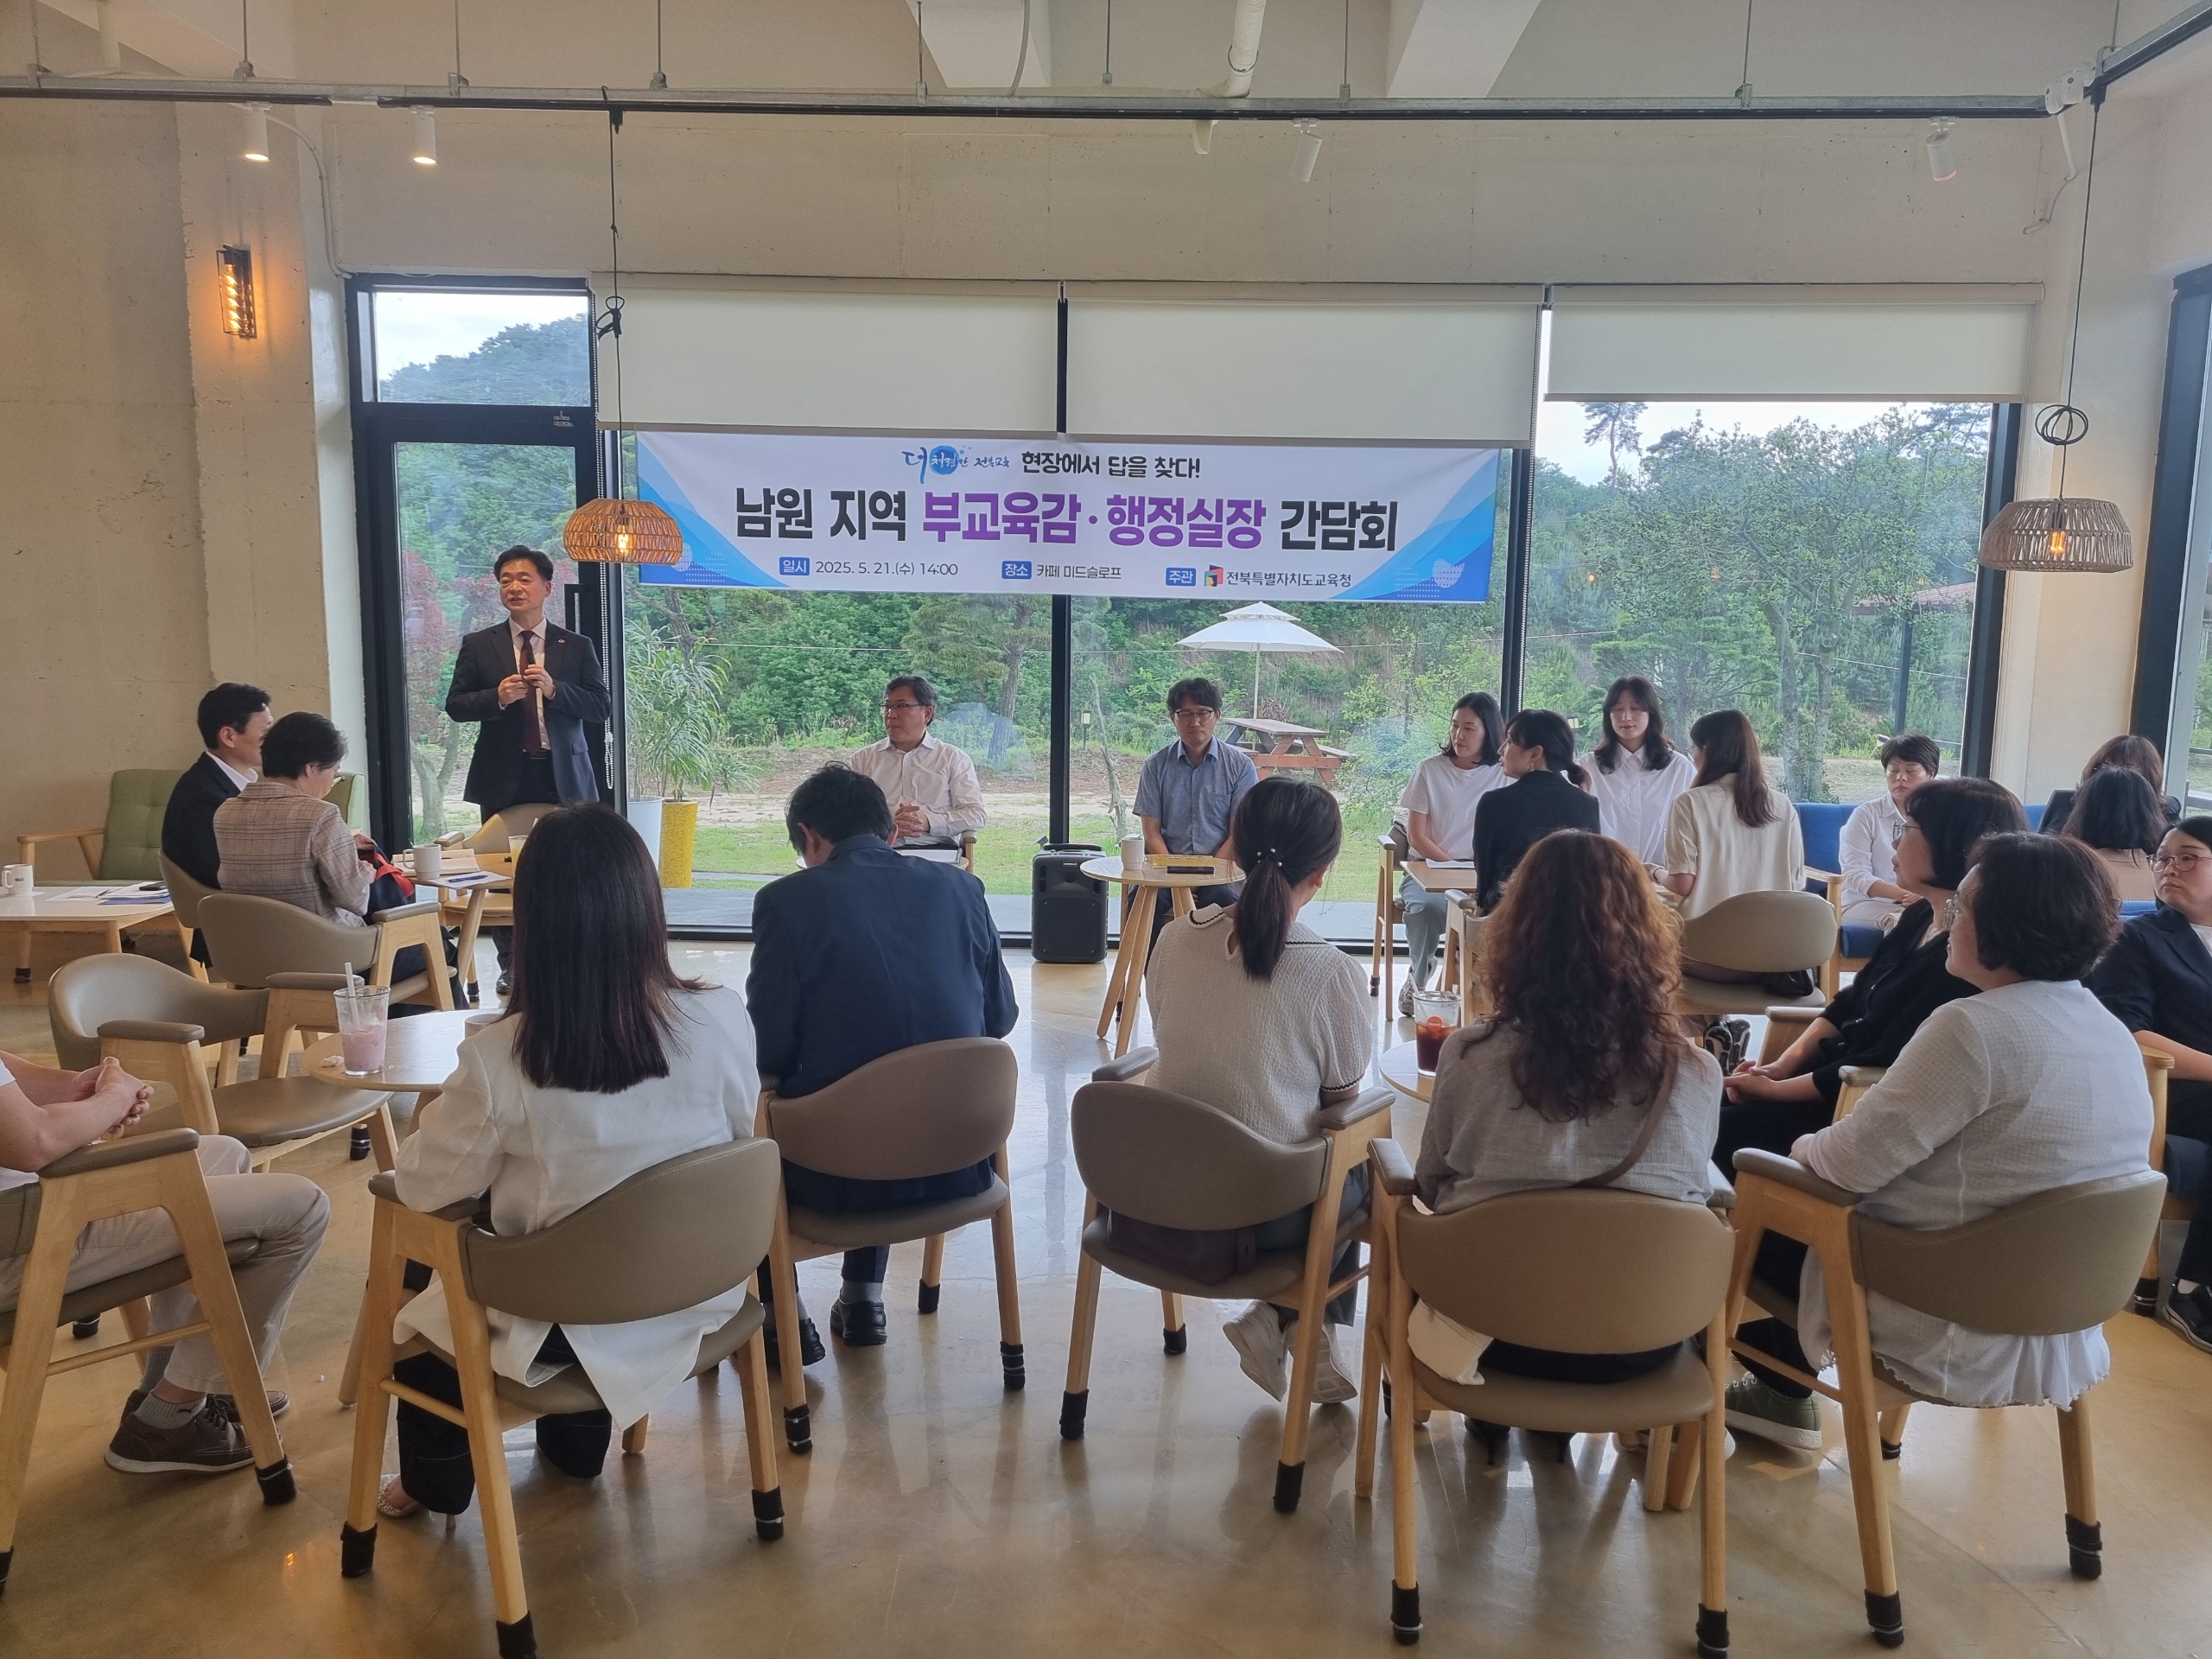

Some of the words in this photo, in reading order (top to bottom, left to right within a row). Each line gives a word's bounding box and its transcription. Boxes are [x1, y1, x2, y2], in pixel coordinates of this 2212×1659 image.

[974, 456, 1010, 469] 전북교육
[1021, 451, 1100, 475] 현장에서
[1108, 456, 1147, 478] 답을
[1154, 456, 1200, 479] 찾다!
[736, 488, 812, 539] 남원
[830, 490, 906, 541] 지역
[1281, 500, 1398, 551] 간담회
[783, 560, 807, 573] 일시
[816, 561, 855, 574] 2025.
[858, 562, 870, 575] 5.
[874, 562, 914, 575] 21.(수)
[920, 563, 958, 575] 14:00
[1005, 563, 1028, 576] 장소
[1036, 564, 1059, 577] 카페
[1064, 565, 1122, 579] 미드슬로프
[1169, 570, 1193, 584] 주관
[1227, 571, 1351, 588] 전북특별자치도교육청
